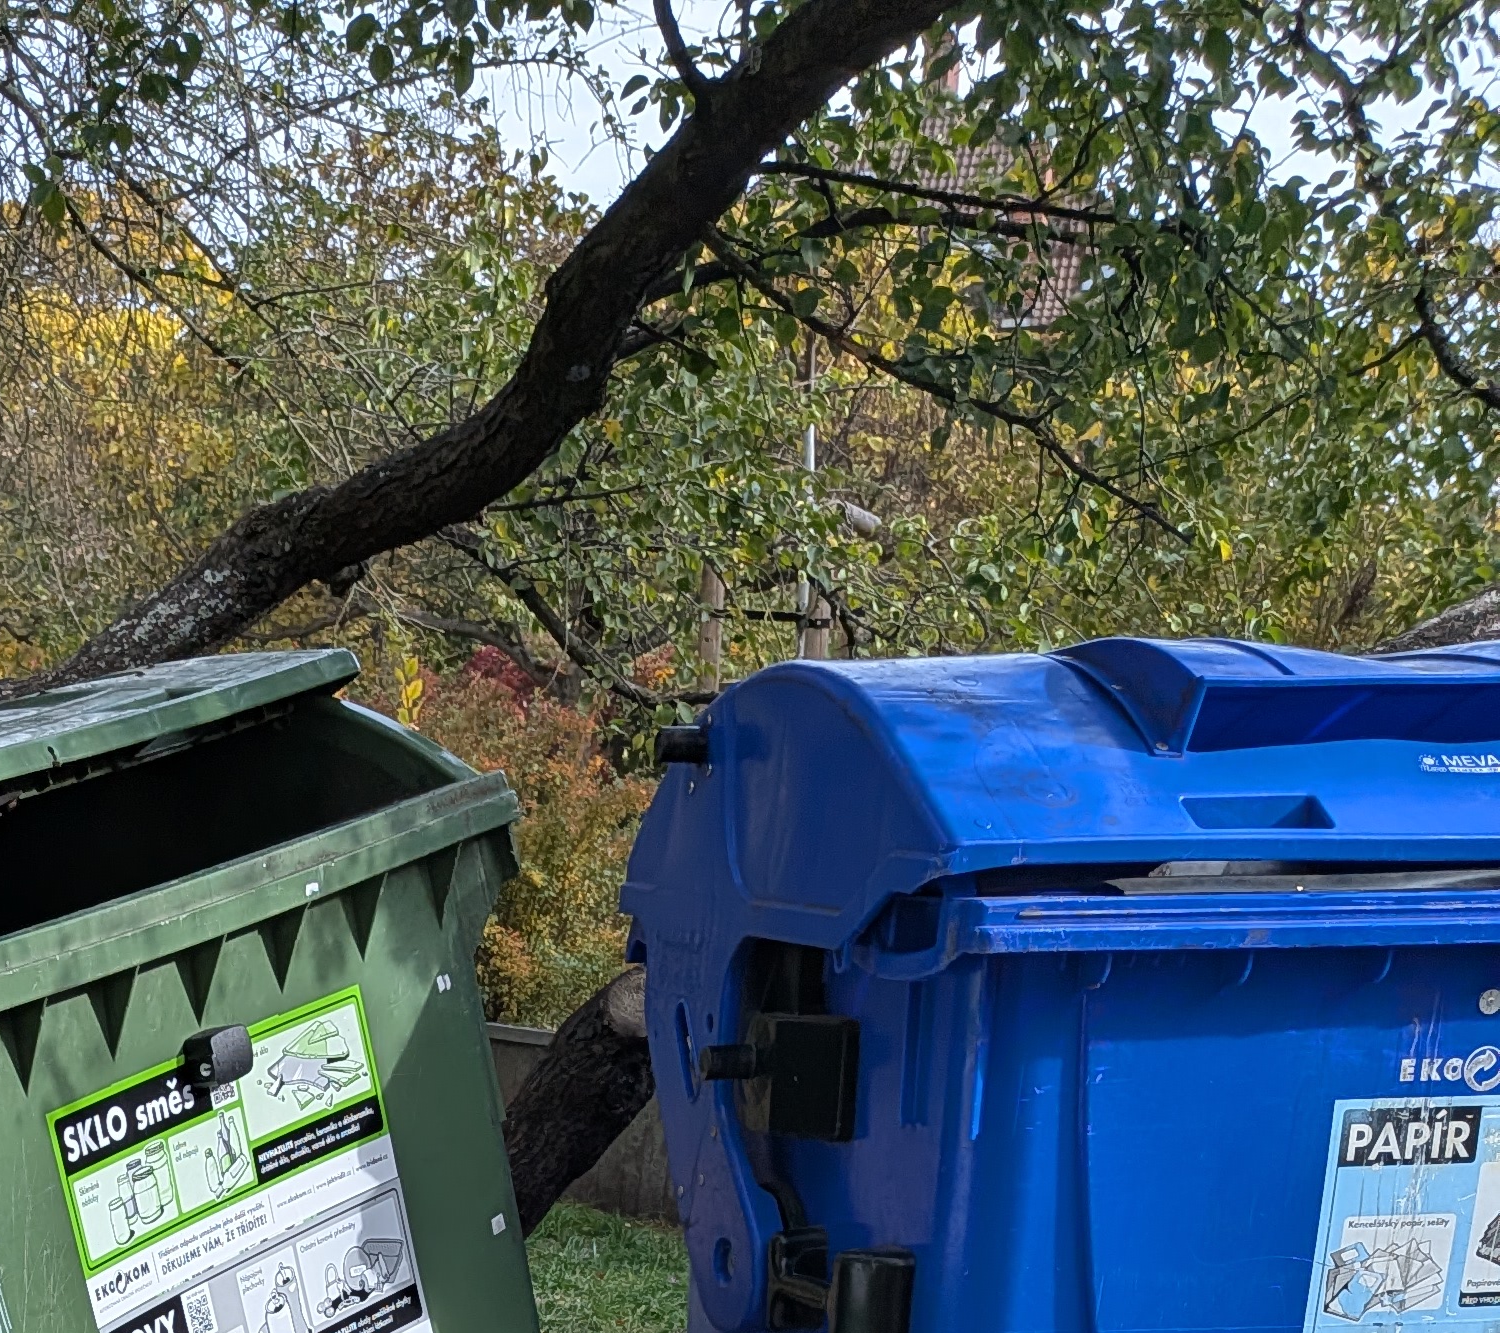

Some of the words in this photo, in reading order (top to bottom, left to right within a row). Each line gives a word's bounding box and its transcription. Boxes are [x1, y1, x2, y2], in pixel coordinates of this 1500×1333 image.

[1399, 1057, 1464, 1082] EKO
[63, 1105, 128, 1163] SKLO
[135, 1077, 195, 1131] směs
[1346, 1109, 1470, 1161] PAPÍR
[162, 1246, 202, 1275] DĚKUJEME
[202, 1236, 224, 1254] VÁM,
[225, 1228, 236, 1243] ŽE
[236, 1213, 268, 1238] TŘÍDÍTE!
